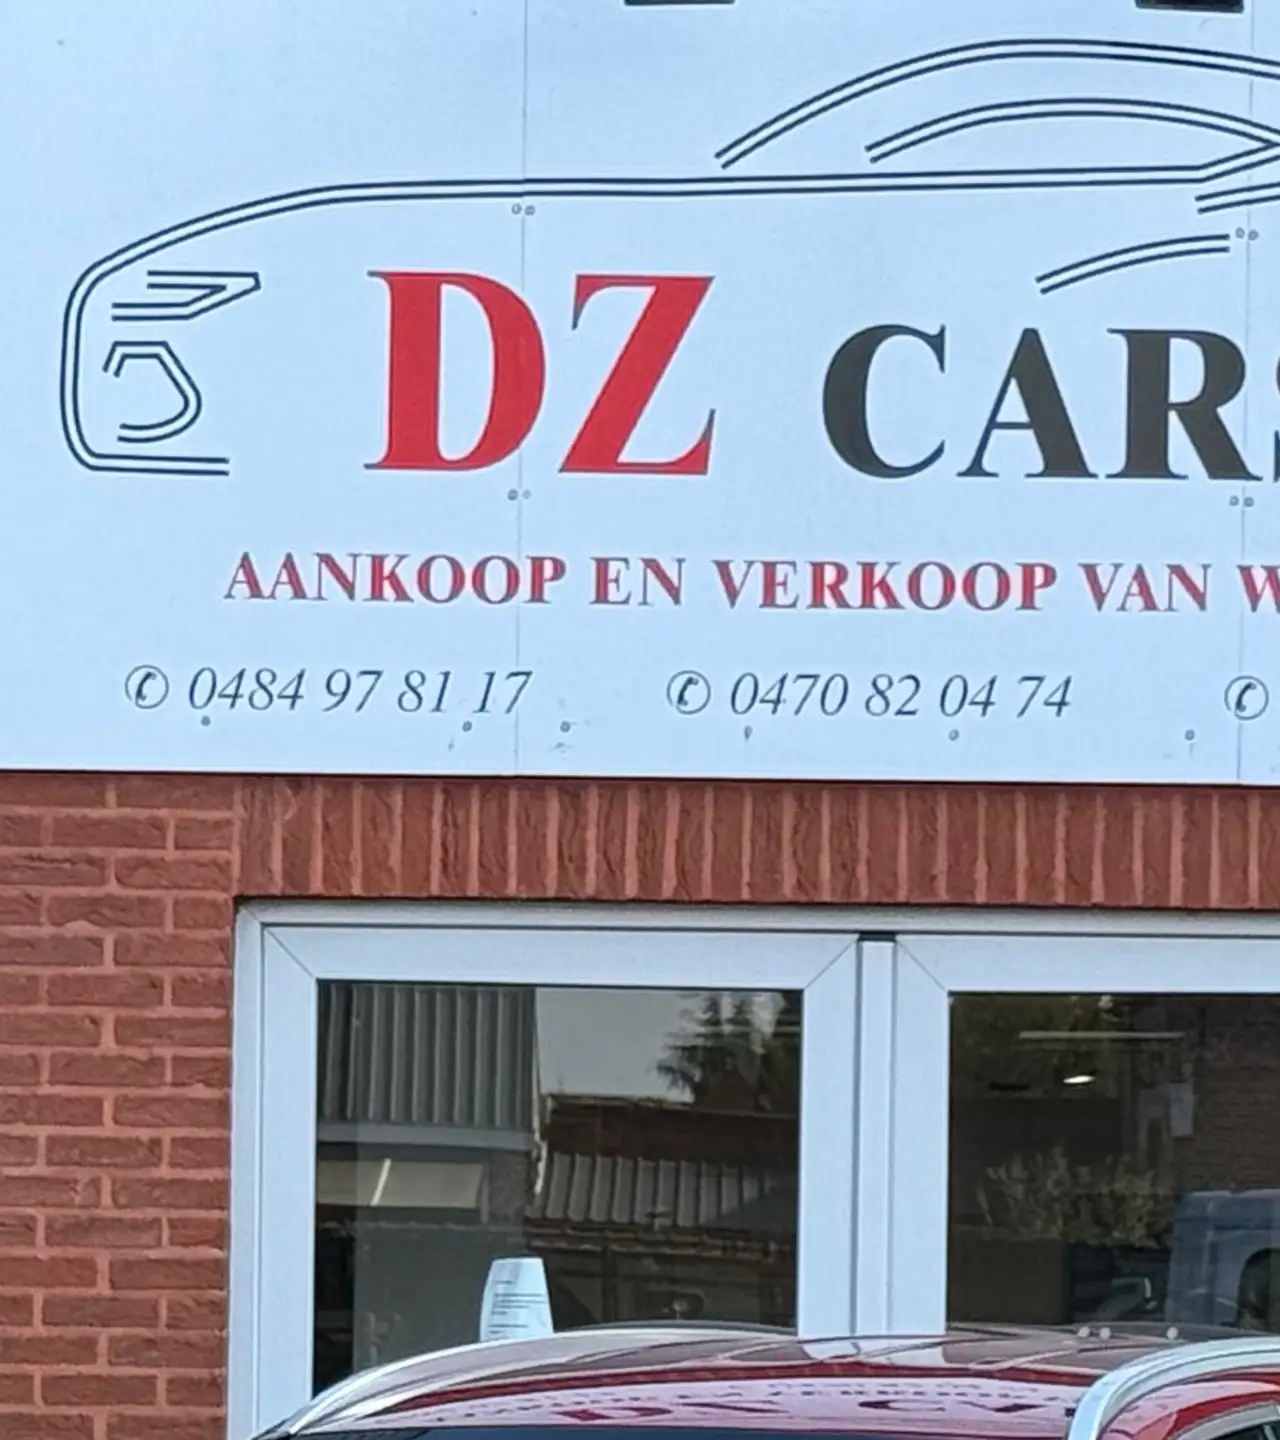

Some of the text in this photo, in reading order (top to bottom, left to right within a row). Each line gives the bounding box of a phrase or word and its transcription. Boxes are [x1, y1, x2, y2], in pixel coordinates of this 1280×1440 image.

[364, 271, 716, 475] DZ
[223, 551, 566, 606] AANKOOP
[589, 557, 686, 608] EN
[710, 560, 1057, 613] VERKOOP
[1077, 563, 1212, 614] VAN
[188, 667, 533, 714] 0484 97 81 17
[730, 672, 1072, 720] 0470 82 04 74
